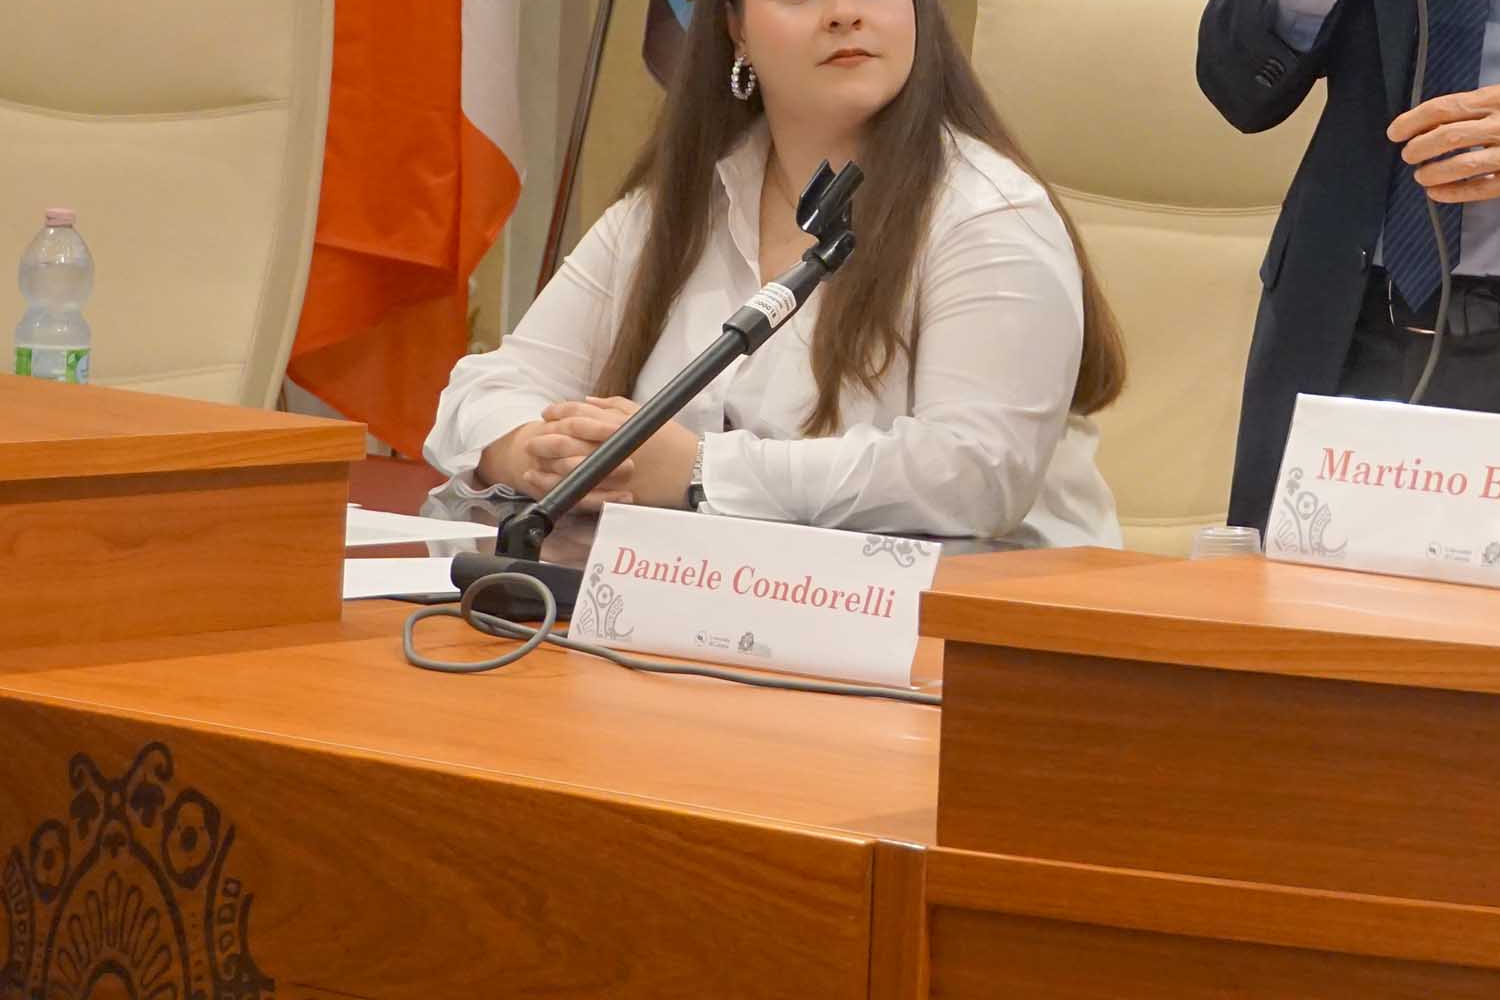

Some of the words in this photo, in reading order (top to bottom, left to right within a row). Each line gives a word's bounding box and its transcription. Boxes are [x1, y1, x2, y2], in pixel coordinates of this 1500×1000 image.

[1316, 446, 1467, 496] Martino
[611, 546, 722, 590] Daniele
[732, 565, 897, 618] Condorelli
